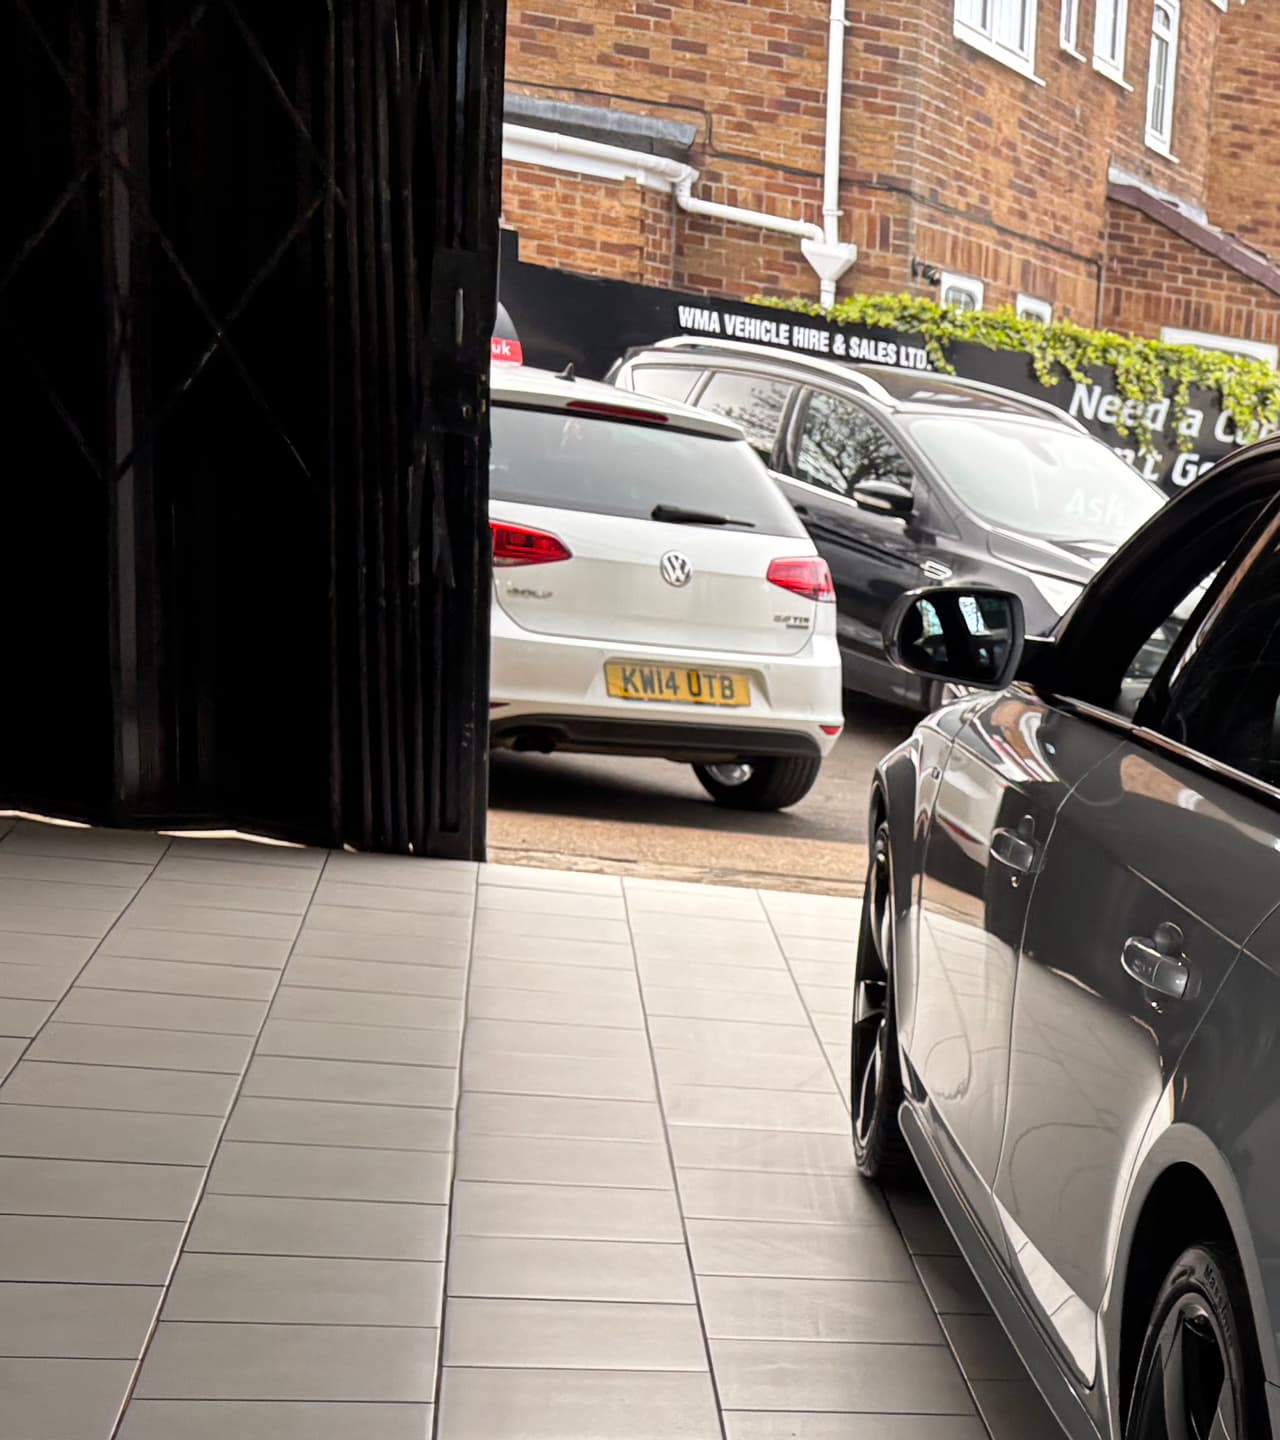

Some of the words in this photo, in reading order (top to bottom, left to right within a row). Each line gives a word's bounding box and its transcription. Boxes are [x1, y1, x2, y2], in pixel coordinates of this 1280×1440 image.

[678, 305, 720, 333] WMA
[724, 314, 790, 345] VEHICLE
[792, 326, 830, 353] HIRE
[832, 334, 847, 355] &
[849, 338, 898, 366] SALES
[899, 346, 933, 371] LTD.
[1069, 383, 1170, 432] Need
[1177, 409, 1204, 437] a
[621, 667, 680, 696] KW14
[687, 670, 735, 700] UTB
